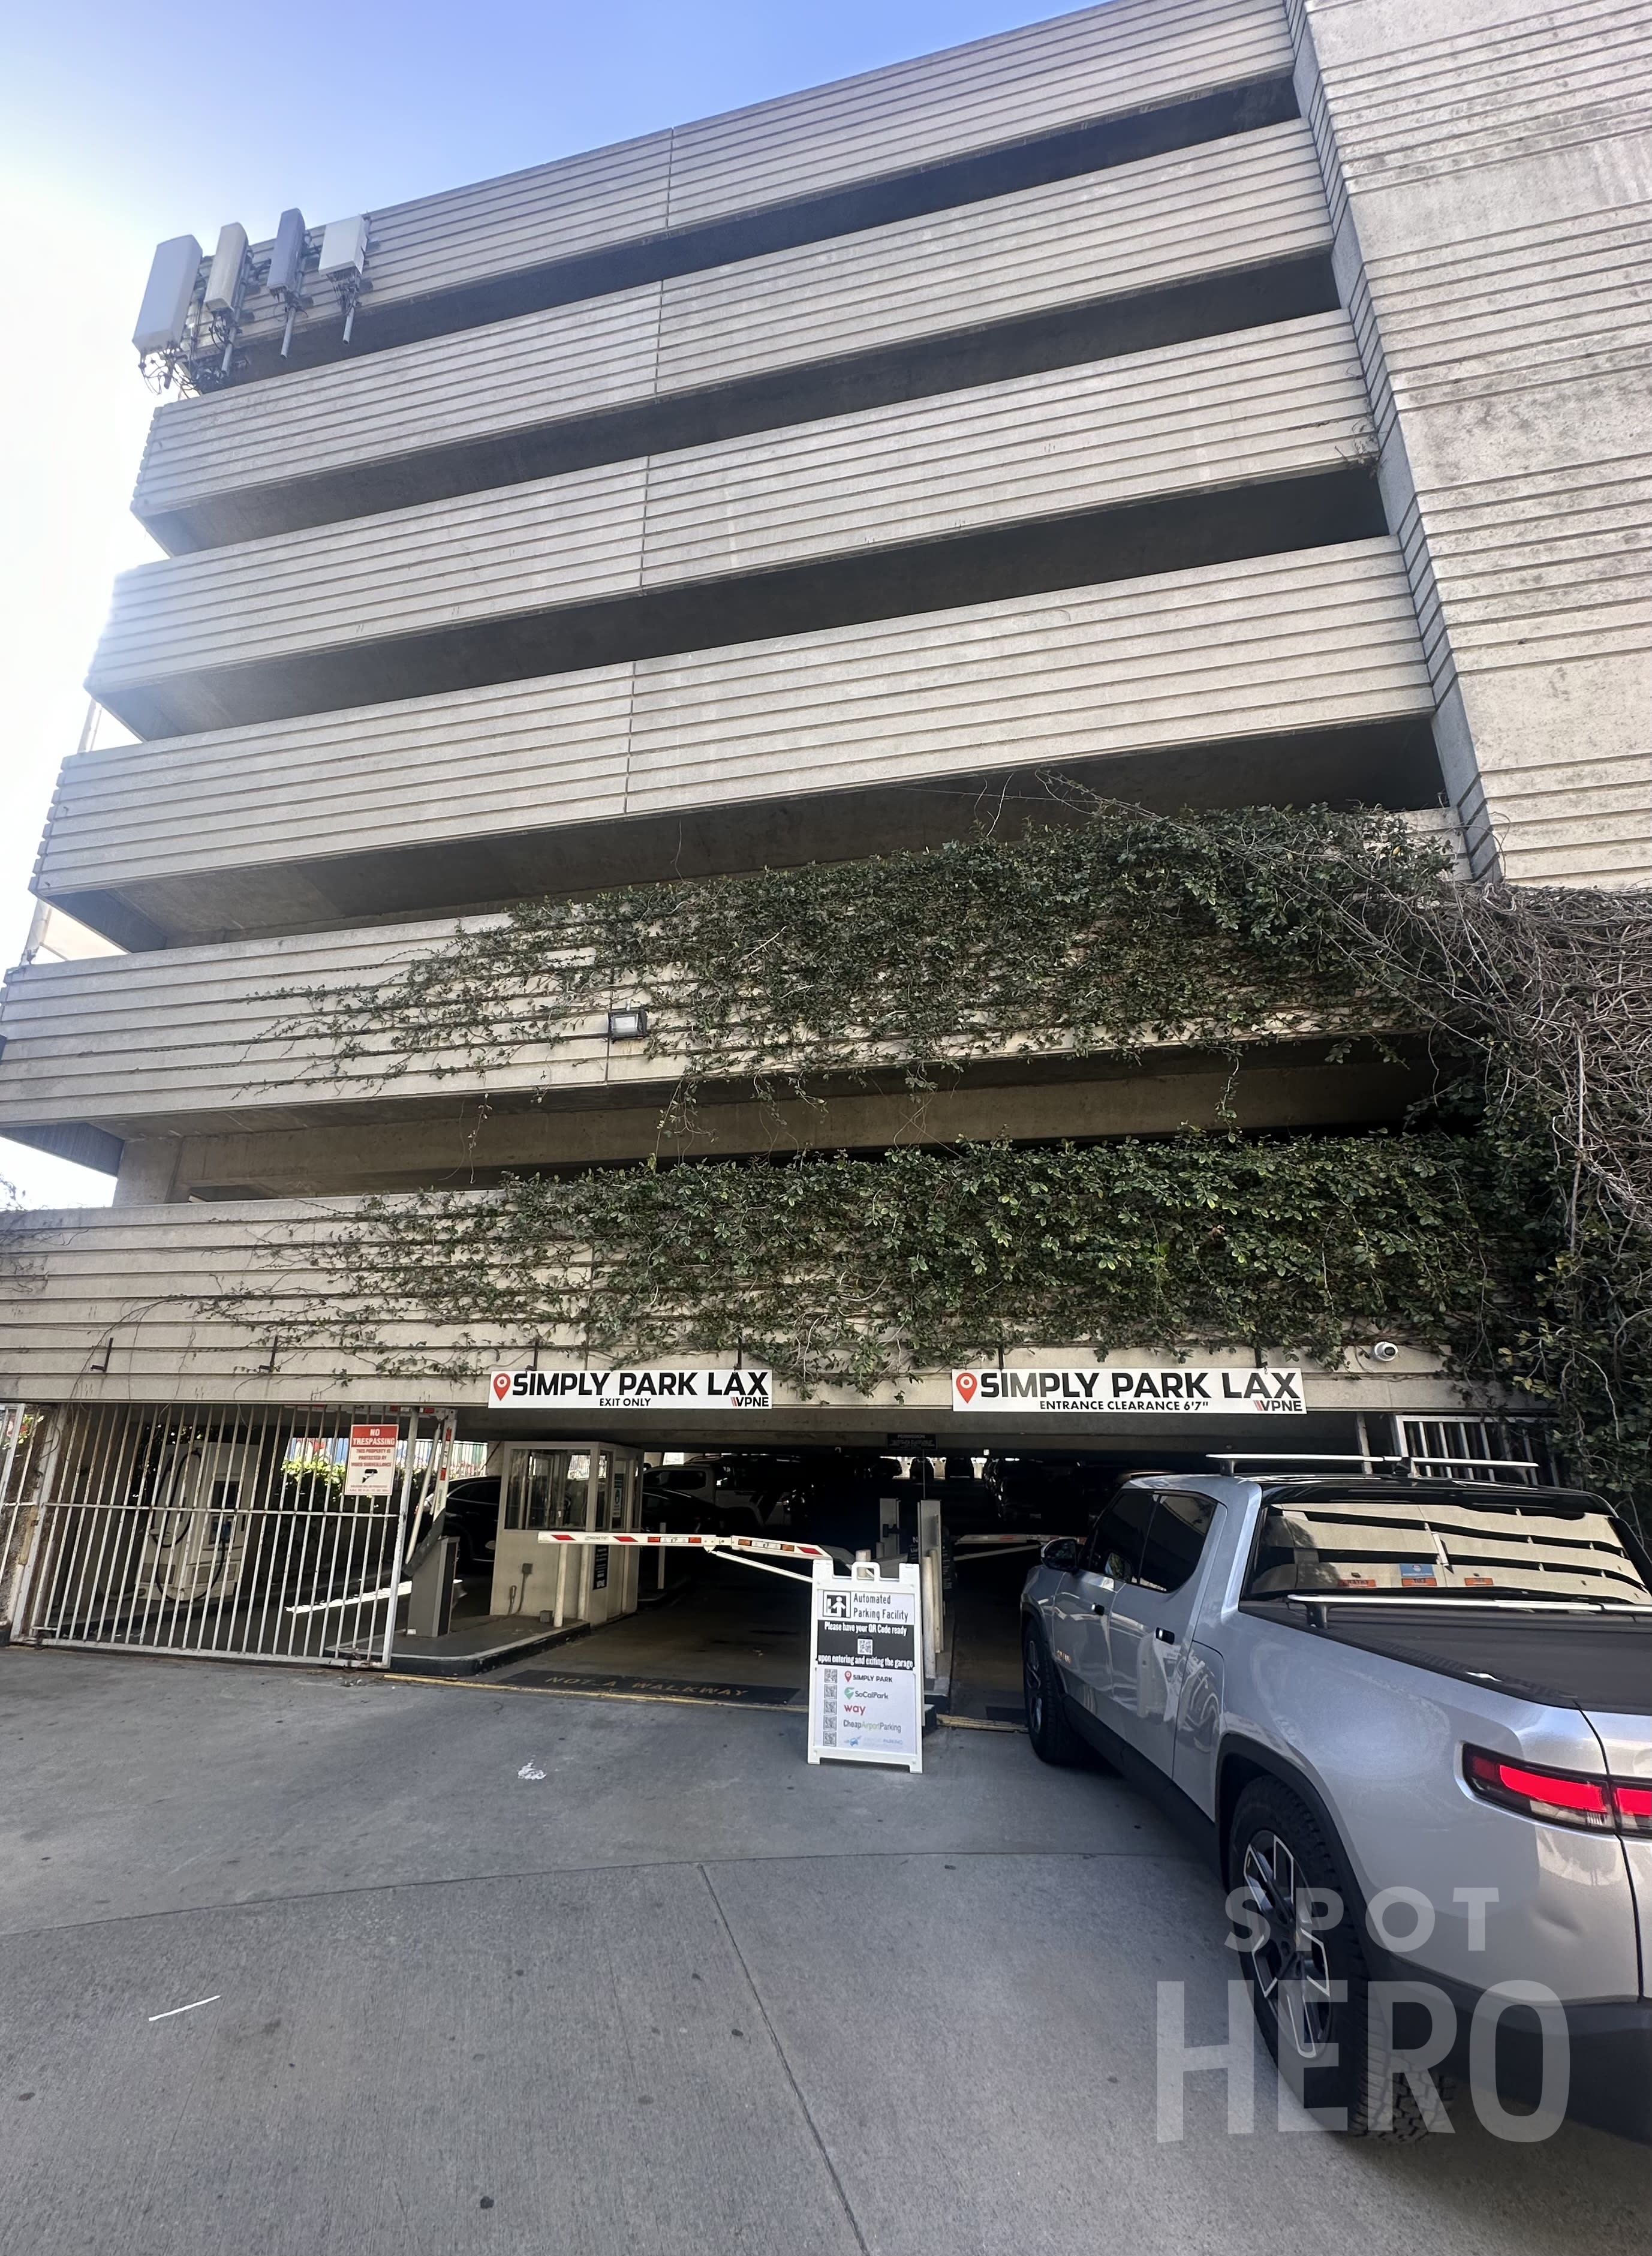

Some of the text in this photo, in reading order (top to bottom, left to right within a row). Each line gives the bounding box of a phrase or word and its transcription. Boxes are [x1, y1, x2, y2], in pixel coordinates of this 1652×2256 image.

[513, 1372, 768, 1395] SIMPLY PARK LAX
[981, 1372, 1300, 1398] SIMPLY PARK LAX
[623, 1398, 651, 1406] ONLY
[736, 1397, 769, 1407] VPNE
[1040, 1401, 1104, 1410] ENTRANCE
[1108, 1401, 1179, 1410] CLEARANCE
[1260, 1400, 1302, 1411] VPNE
[853, 1593, 891, 1604] Automated
[854, 1608, 908, 1623] Parking Facility
[825, 1621, 907, 1636] Please have your QR Code ready
[818, 1655, 913, 1669] upon entering and exiting the garage
[546, 1677, 595, 1686] NOT
[632, 1681, 748, 1696] WALKWAY
[855, 1691, 889, 1699] SoCalPark
[844, 1704, 866, 1716] way
